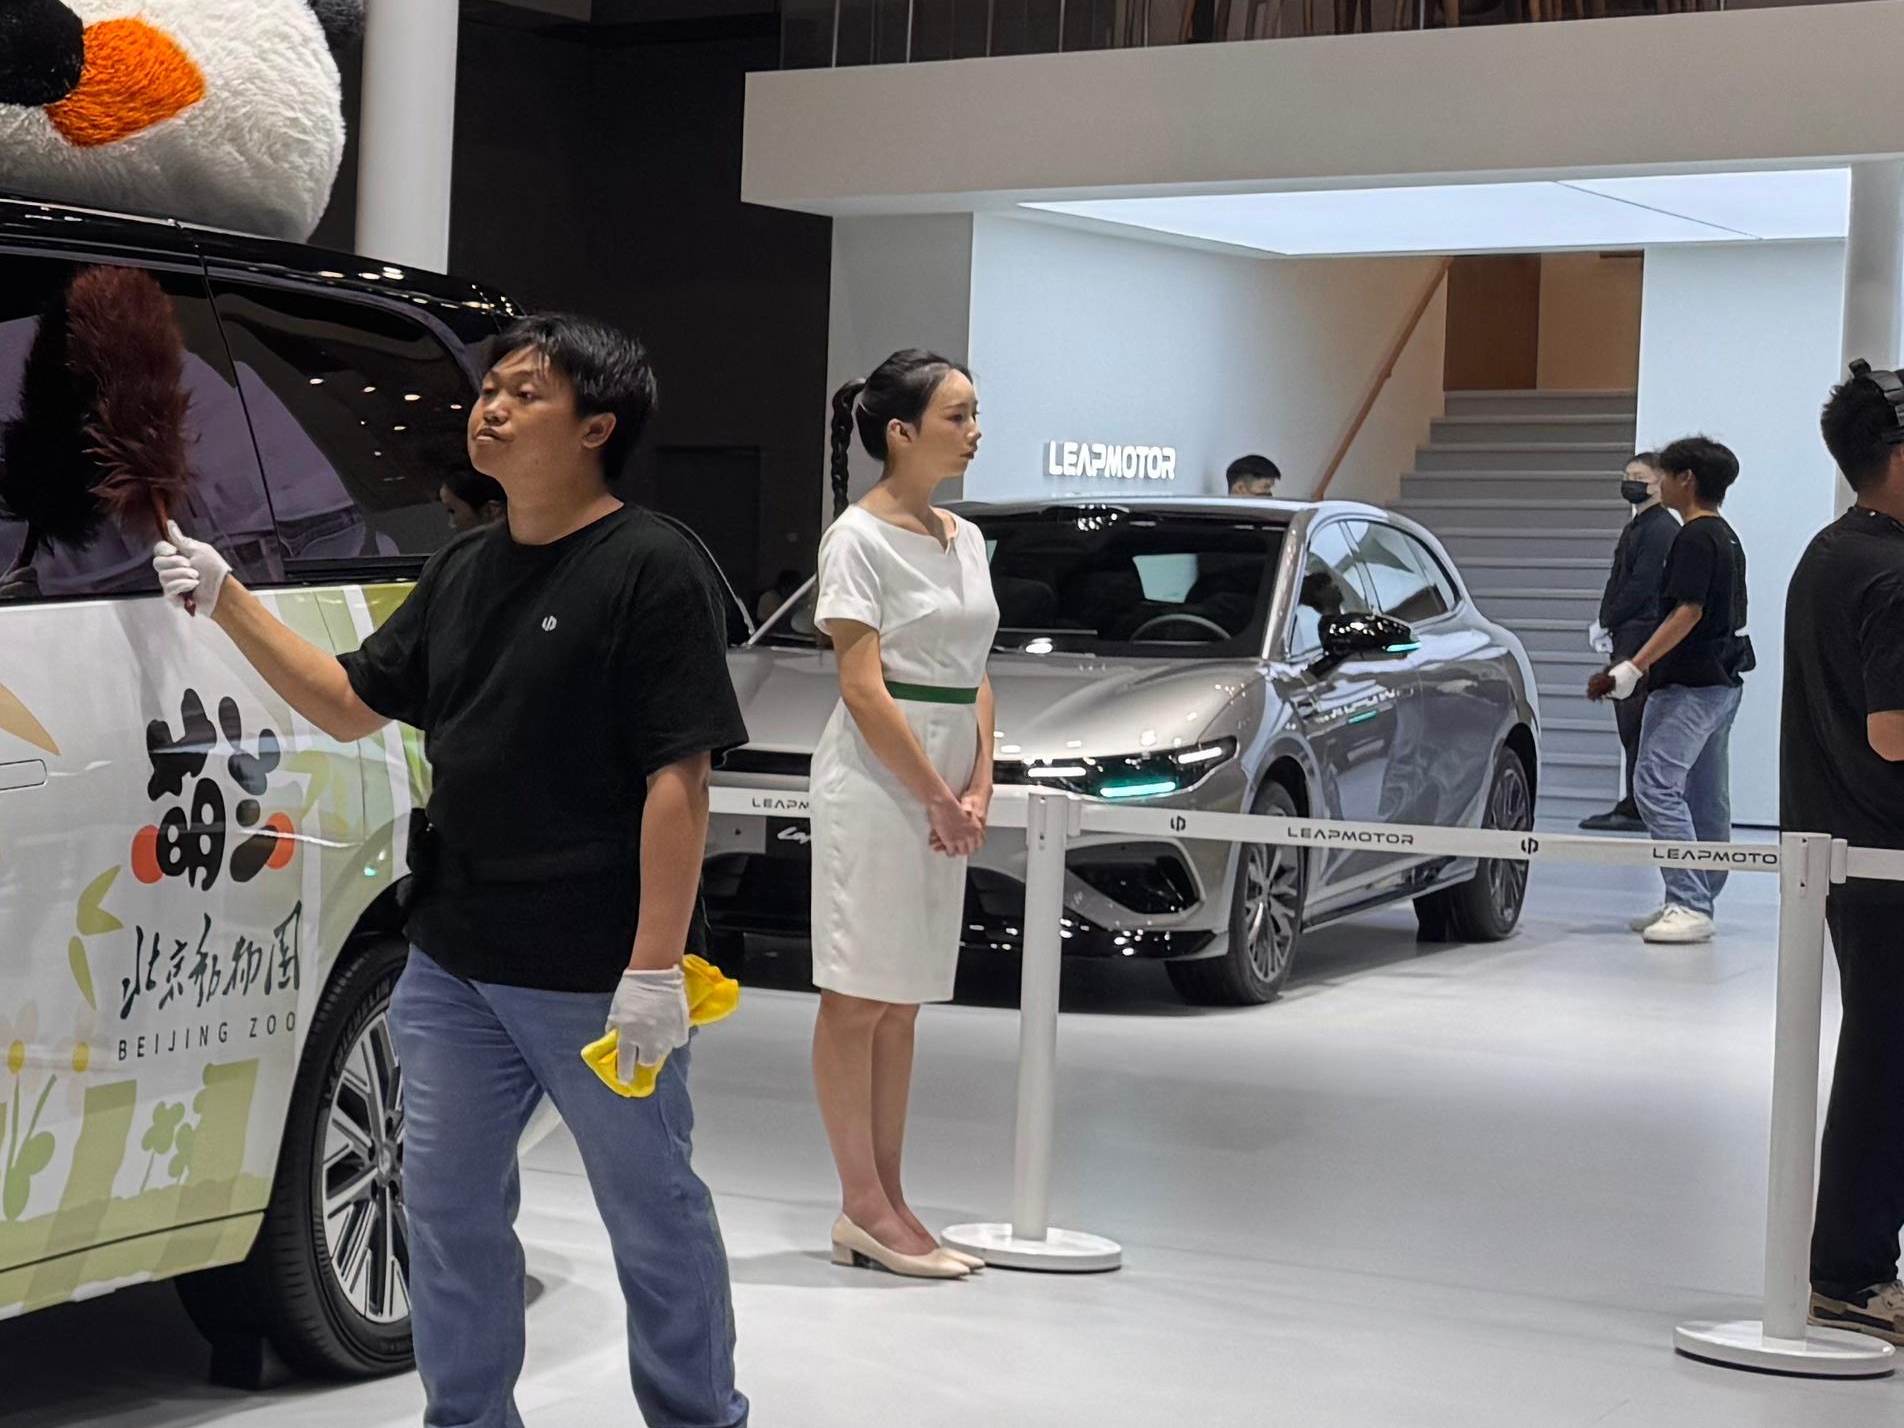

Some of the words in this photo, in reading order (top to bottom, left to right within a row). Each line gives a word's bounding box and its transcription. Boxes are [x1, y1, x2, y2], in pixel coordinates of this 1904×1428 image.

[1049, 440, 1176, 480] LEAPMOTOR
[752, 796, 810, 810] LEAPM
[1287, 827, 1414, 845] LEAPMOTOR
[1653, 847, 1778, 865] LEAPMOTO
[120, 900, 303, 1020] 北京动物园
[118, 1022, 228, 1061] BEIJING
[249, 1011, 296, 1038] ZOO
